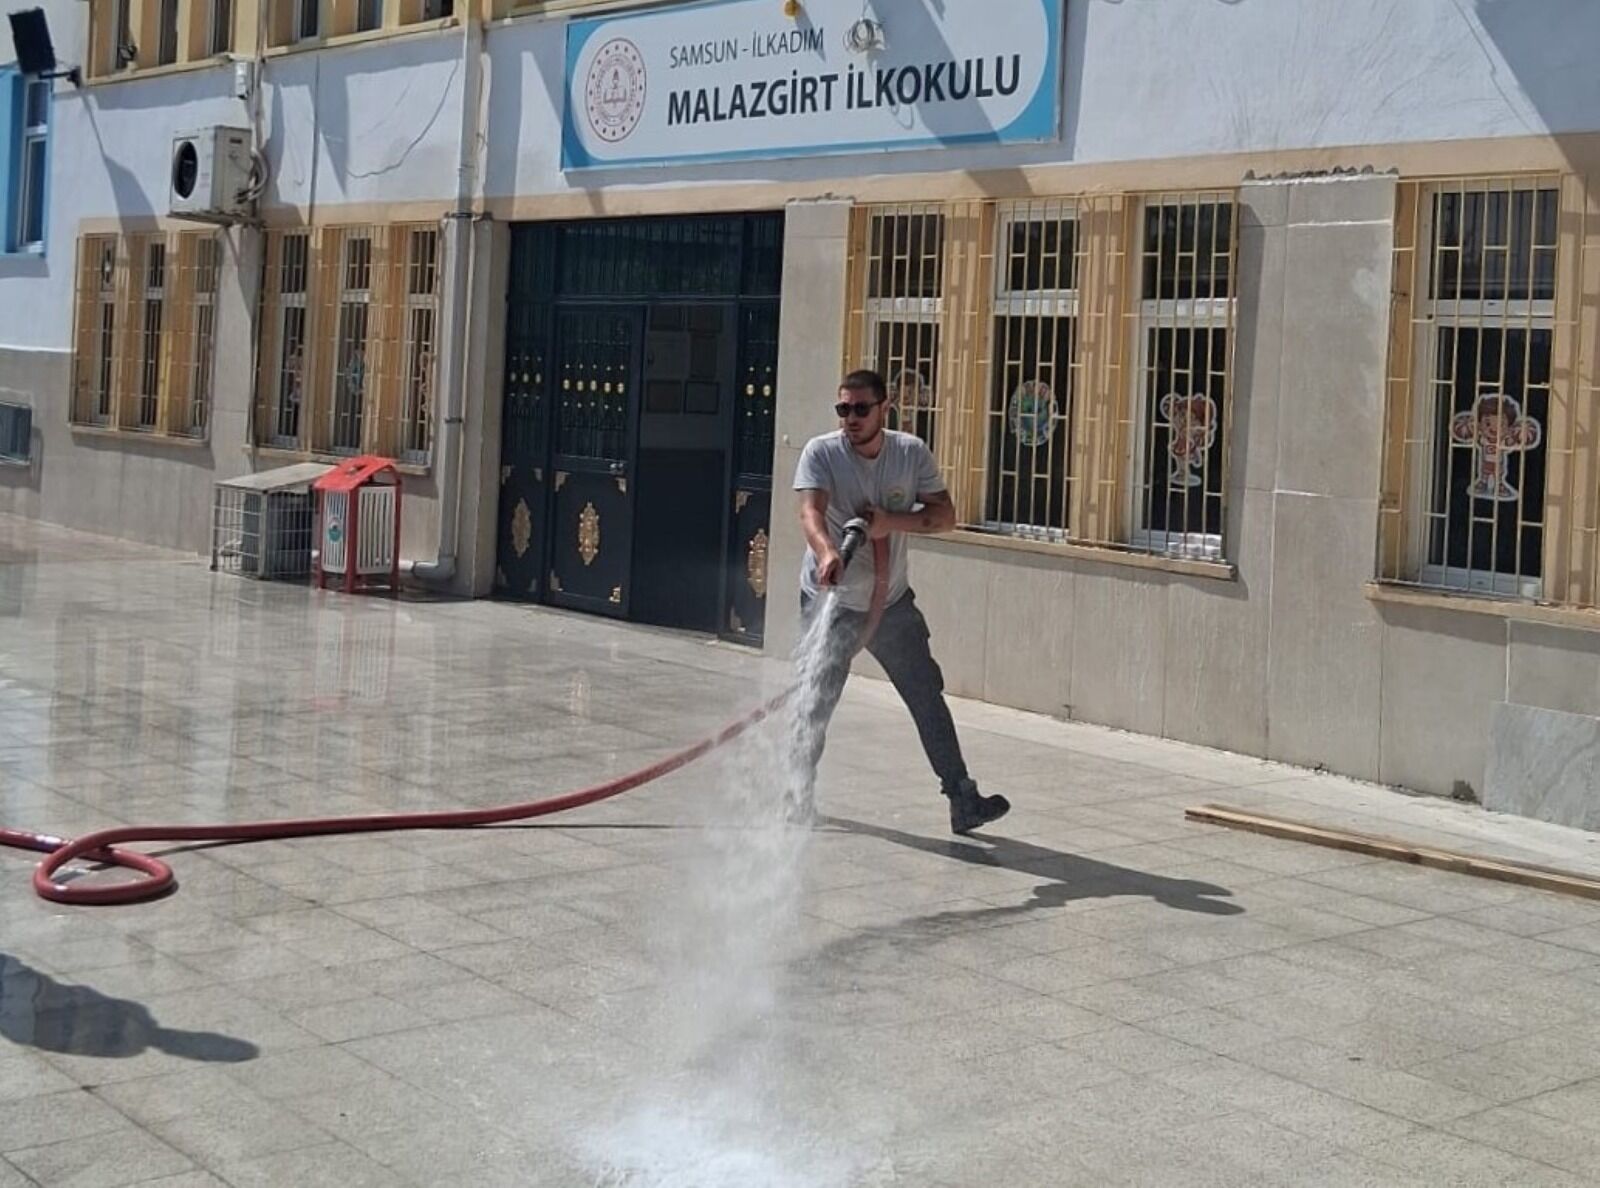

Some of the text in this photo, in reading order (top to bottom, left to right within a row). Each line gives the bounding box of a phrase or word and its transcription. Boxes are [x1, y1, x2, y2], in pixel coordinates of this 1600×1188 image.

[669, 38, 738, 69] SAMSUN
[751, 27, 824, 58] İLKADIM
[667, 70, 839, 126] MALAZGİRT
[846, 54, 1021, 109] İLKOKULU
